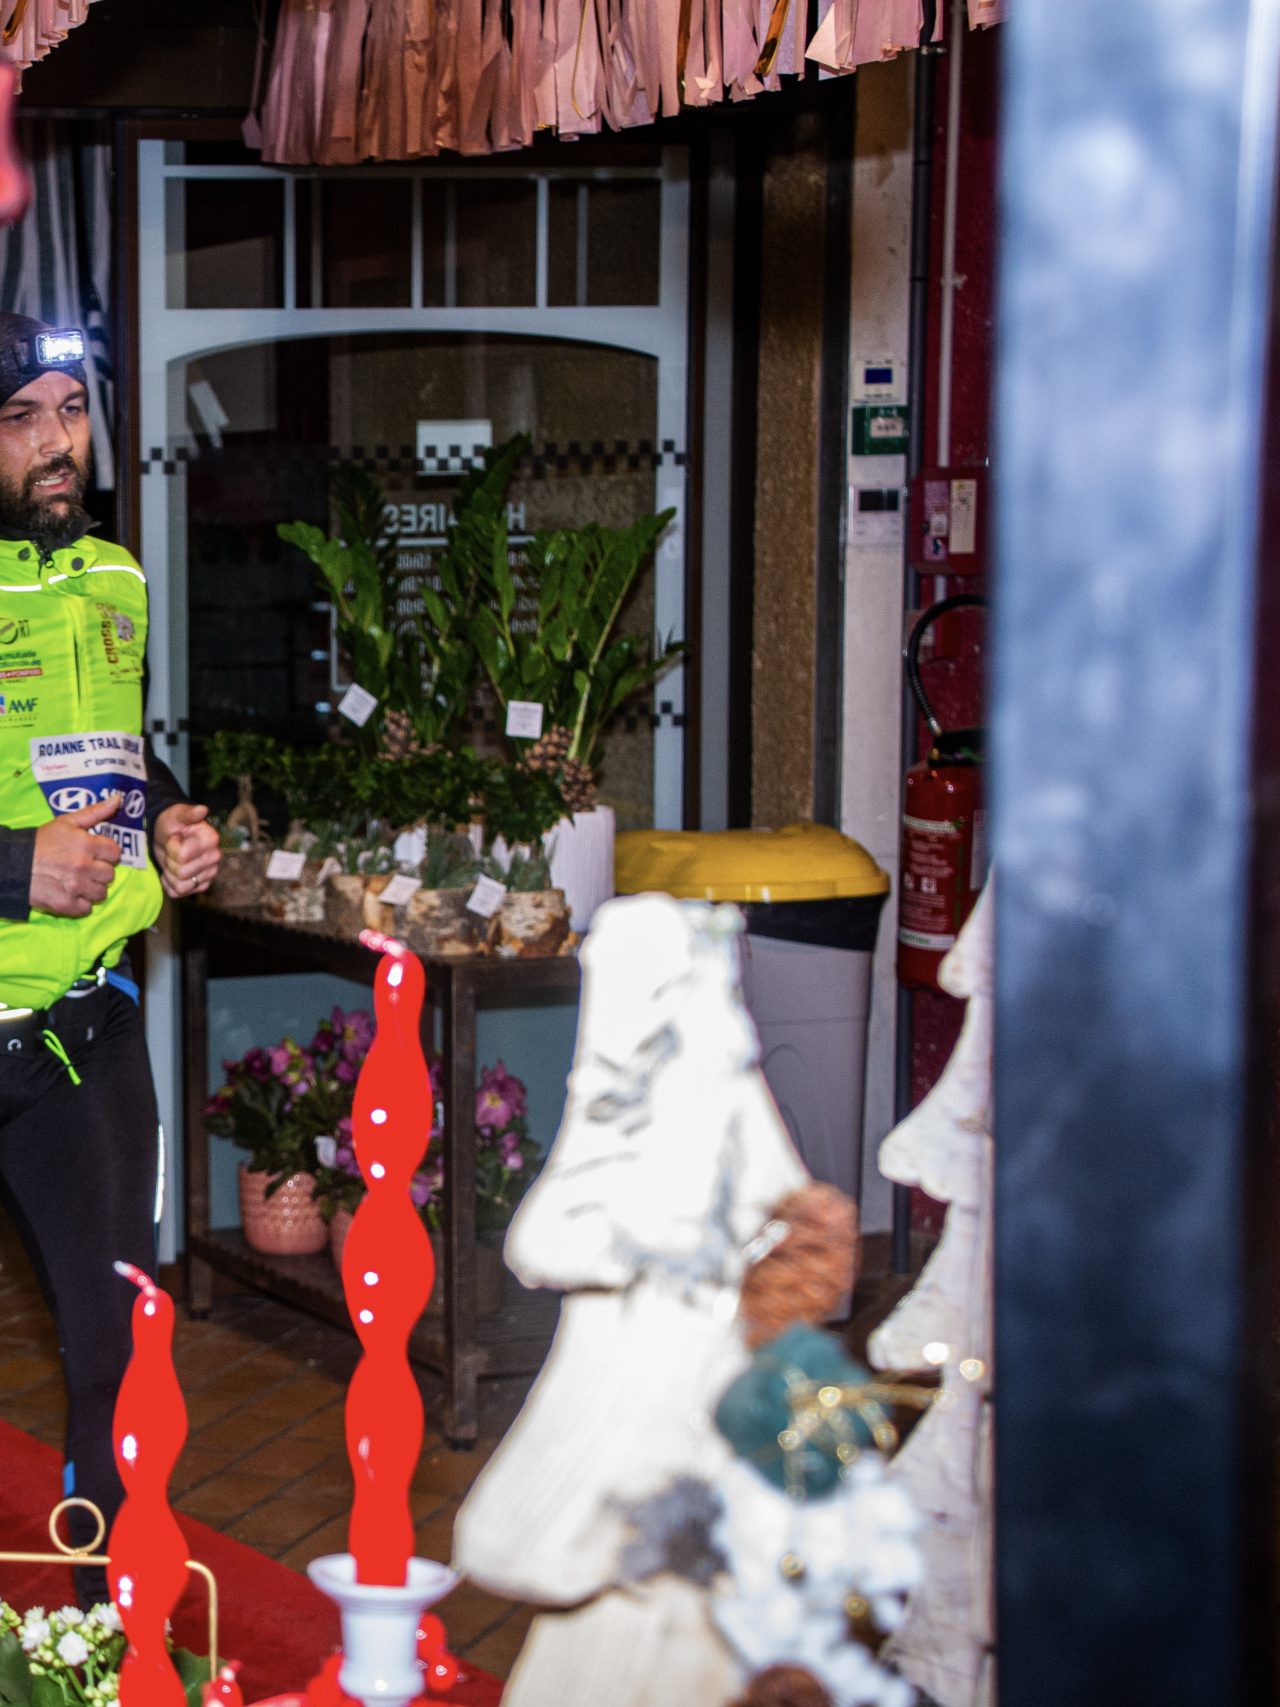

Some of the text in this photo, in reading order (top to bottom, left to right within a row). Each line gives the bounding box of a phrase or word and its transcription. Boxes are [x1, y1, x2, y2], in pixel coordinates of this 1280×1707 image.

[8, 697, 39, 713] AMF
[38, 740, 86, 757] ROANNE
[89, 737, 121, 751] TRAIL
